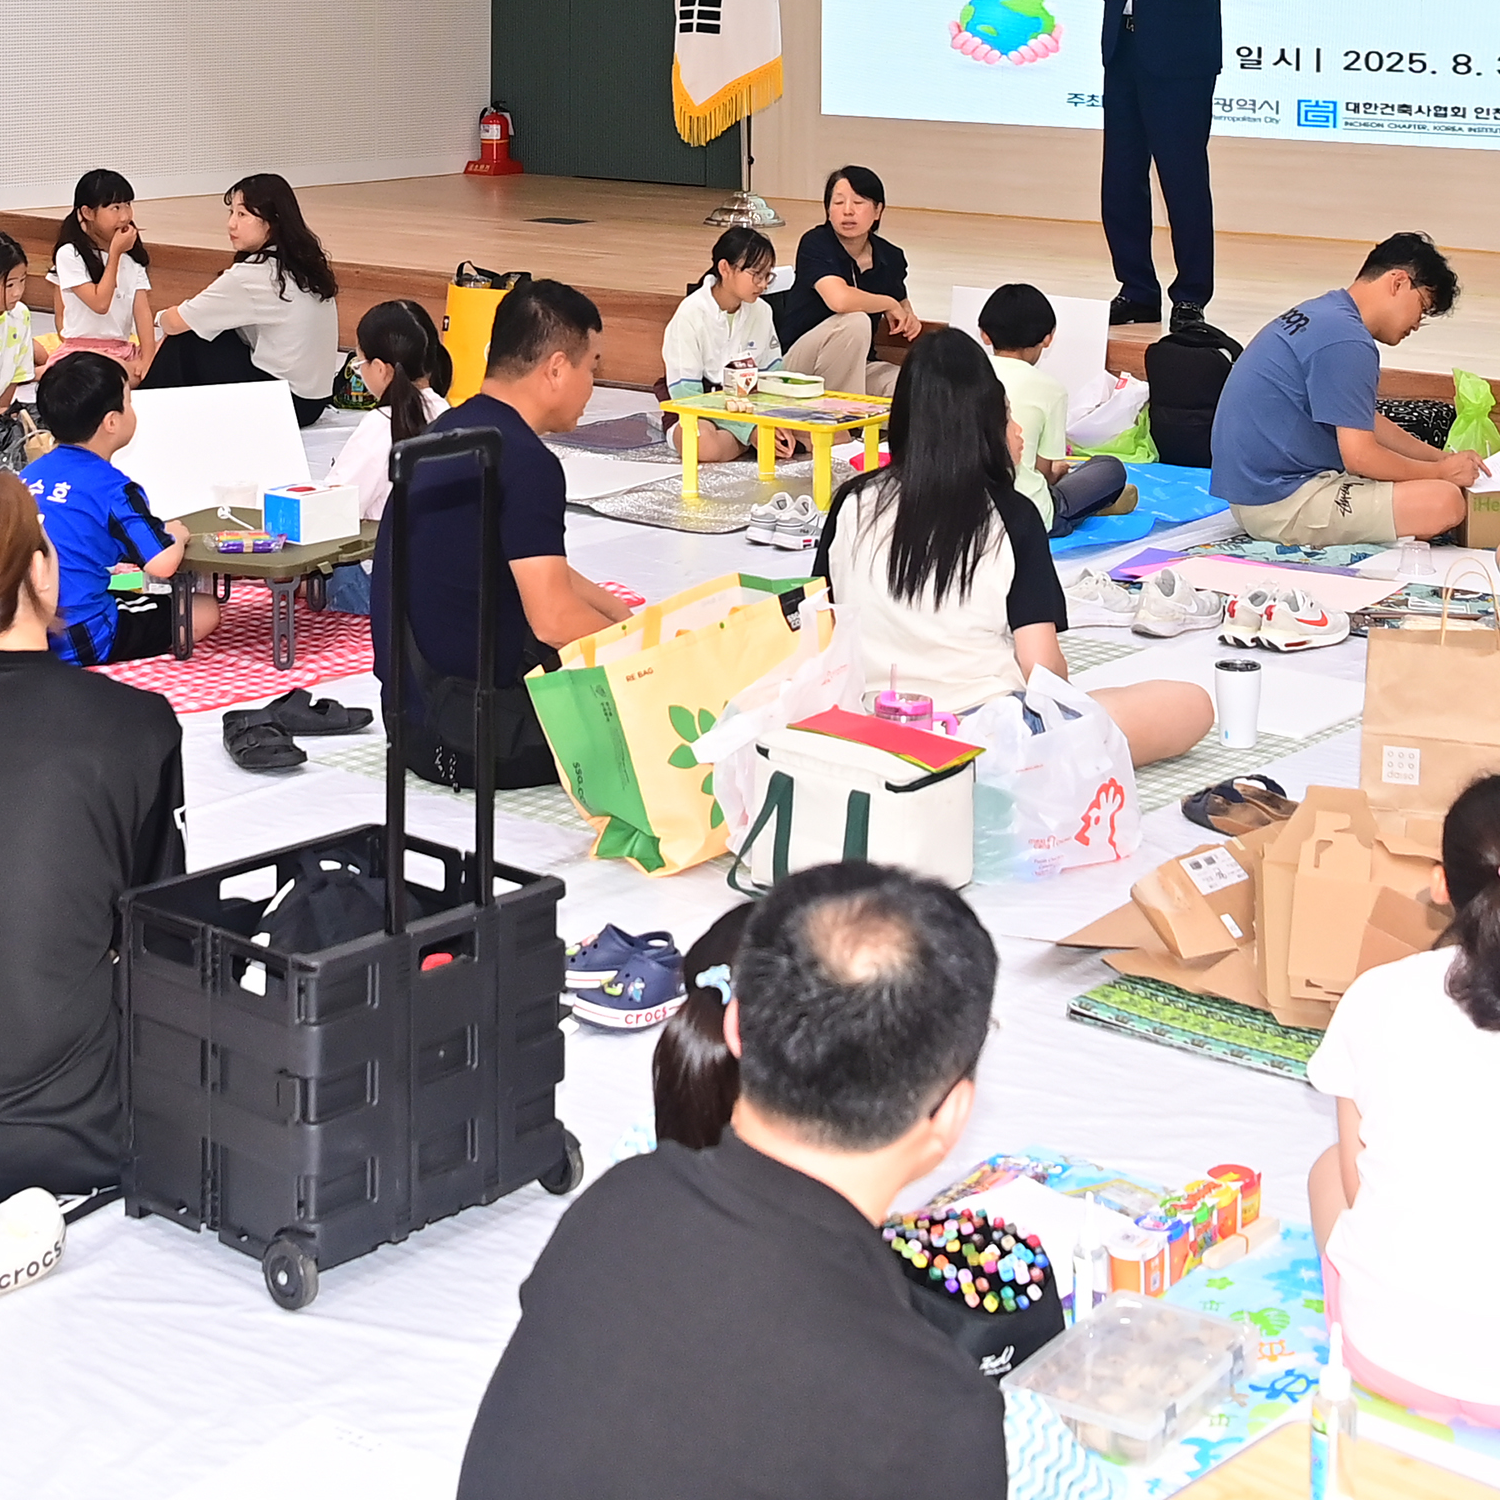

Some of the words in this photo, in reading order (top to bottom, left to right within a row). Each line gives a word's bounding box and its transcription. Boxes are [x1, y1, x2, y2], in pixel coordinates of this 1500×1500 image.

[1342, 50, 1438, 75] 2025.
[1451, 53, 1483, 77] 8.
[1344, 100, 1468, 120] 대한건축사협회
[625, 672, 637, 683] RE
[636, 667, 654, 679] BAG
[624, 1006, 668, 1025] crocs
